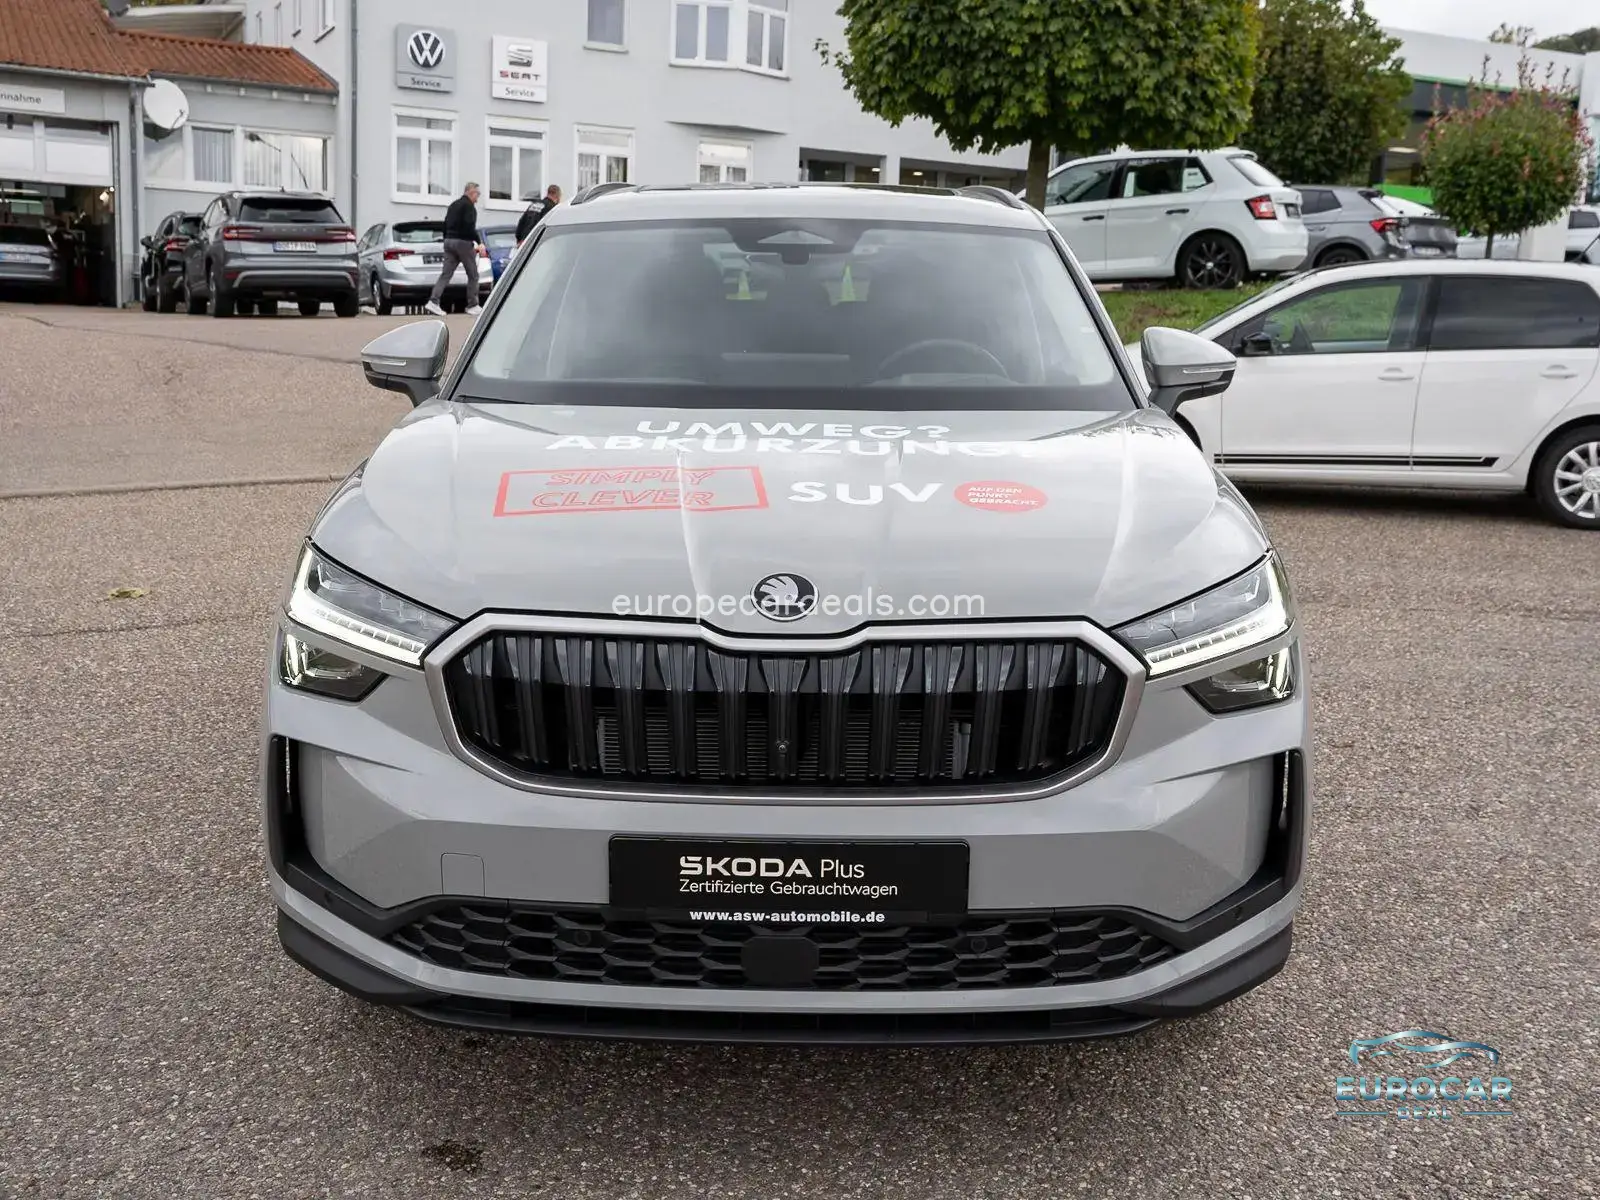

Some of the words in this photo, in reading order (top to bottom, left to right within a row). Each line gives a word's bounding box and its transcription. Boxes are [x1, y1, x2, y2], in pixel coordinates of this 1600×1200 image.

[410, 77, 441, 88] Service
[500, 70, 540, 81] SEAT
[505, 87, 535, 97] Service
[636, 421, 950, 438] UMWEG?
[545, 469, 716, 486] SIMPLY
[533, 489, 715, 508] CLEVER
[788, 481, 944, 505] SUV
[820, 859, 865, 878] Plus
[679, 878, 765, 894] Zertifizierte
[770, 880, 898, 898] Gebrauchtwagen
[689, 910, 886, 923] www.asw-automobile.de
